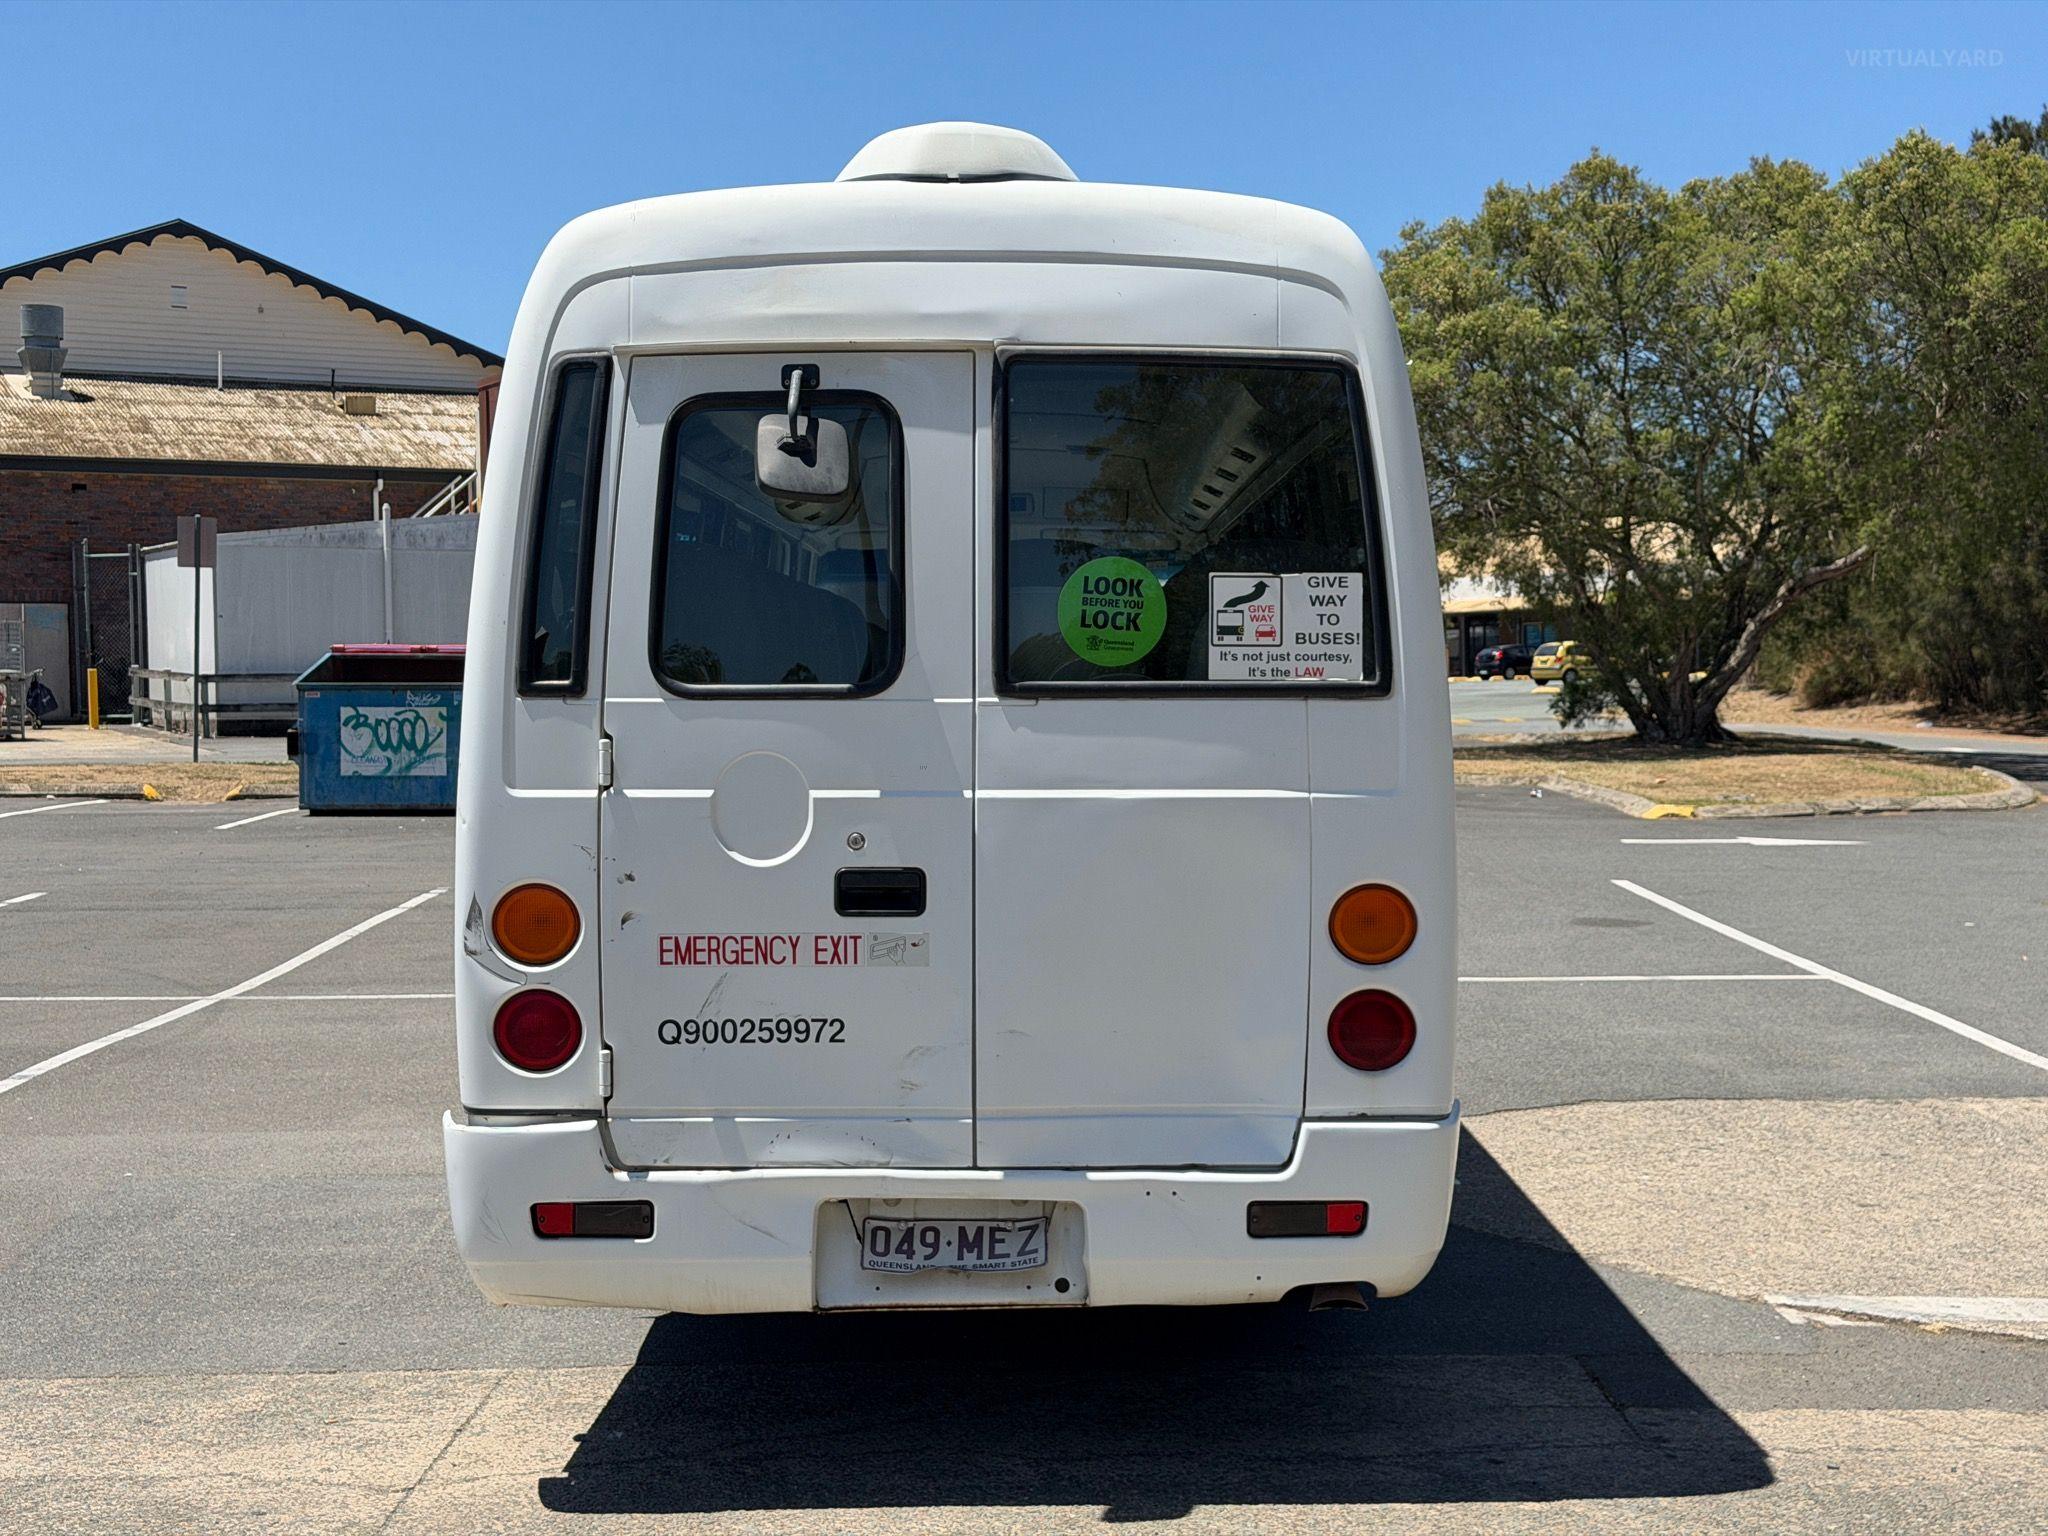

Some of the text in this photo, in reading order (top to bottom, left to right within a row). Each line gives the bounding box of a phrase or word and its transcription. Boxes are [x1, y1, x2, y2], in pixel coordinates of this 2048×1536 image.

[1082, 576, 1144, 598] LOOK
[1307, 576, 1349, 588] GIVE
[1082, 597, 1144, 609] BEFORE YOU
[1309, 595, 1347, 607] WAY
[1248, 605, 1275, 613] GIVE
[1080, 609, 1141, 632] LOCK
[1249, 614, 1275, 623] WAY
[1316, 613, 1340, 626] TO
[1295, 632, 1360, 645] BUSES!
[1219, 651, 1352, 664] It's not just courtesy,
[1249, 667, 1325, 677] It's the LAW
[659, 935, 862, 965] EMERGENCY EXIT
[658, 1018, 846, 1044] Q900259972
[1010, 1257, 1039, 1267] STATE
